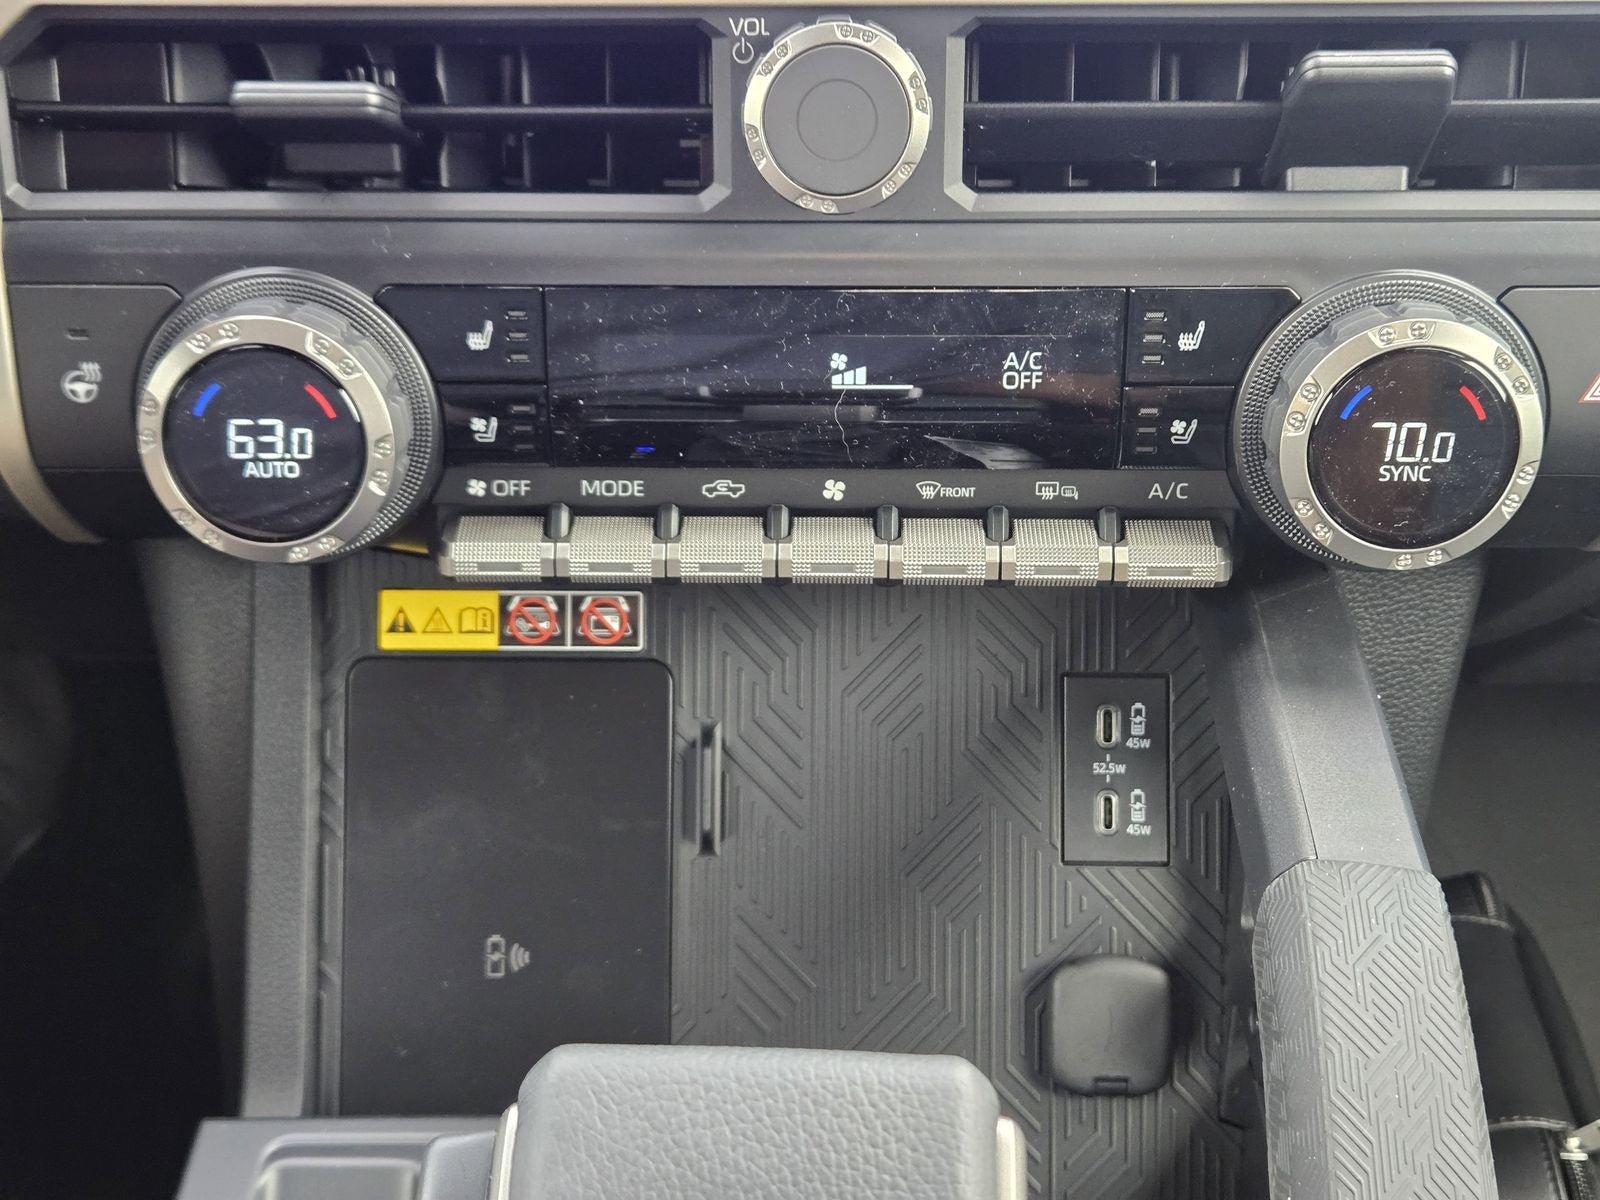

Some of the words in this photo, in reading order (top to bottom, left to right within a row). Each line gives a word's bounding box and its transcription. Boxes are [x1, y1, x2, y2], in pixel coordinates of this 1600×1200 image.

[728, 17, 770, 36] VOL
[1003, 351, 1043, 370] A/C
[1002, 372, 1043, 390] OFF
[227, 418, 313, 459] 63.0
[1371, 422, 1456, 463] 70.0
[242, 461, 301, 478] AUTO
[1378, 465, 1432, 482] SYNC
[491, 480, 532, 496] OFF
[580, 480, 645, 496] MODE
[940, 486, 976, 498] FRONT
[1148, 483, 1189, 500] A/C
[1125, 738, 1151, 749] 45W
[1092, 763, 1126, 774] 52.5W
[1126, 824, 1151, 836] 45W
